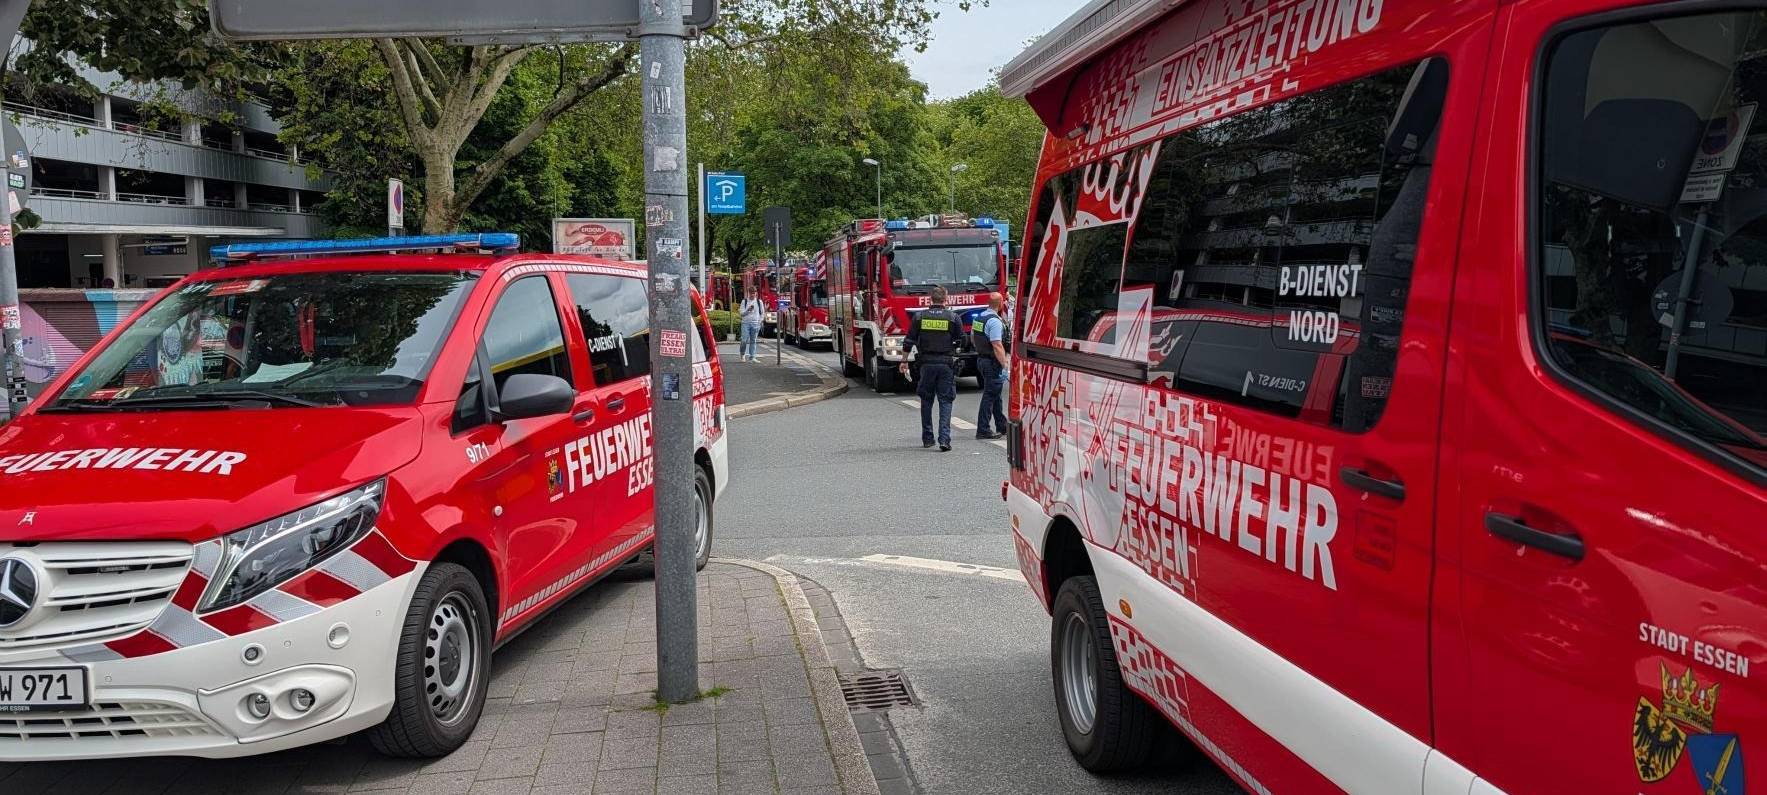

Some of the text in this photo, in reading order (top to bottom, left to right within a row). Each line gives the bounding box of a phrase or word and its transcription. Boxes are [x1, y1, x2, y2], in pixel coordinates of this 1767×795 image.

[1153, 0, 1383, 113] EINSATZLEITUNG
[722, 185, 733, 202] P
[1279, 265, 1362, 297] B-DIENST
[919, 294, 975, 306] FEWEHR
[922, 320, 948, 330] POLIZEI
[1288, 311, 1339, 344] NORD
[588, 333, 629, 367] C-DIENST 1
[661, 339, 685, 348] ESSEN
[466, 441, 490, 464] 9/71
[628, 456, 654, 498] ESSE
[1110, 421, 1338, 591] FEUERWEHR
[1126, 499, 1190, 581] ESSEN
[1639, 622, 1749, 678] STADT ESSEN
[22, 674, 72, 701] 971
